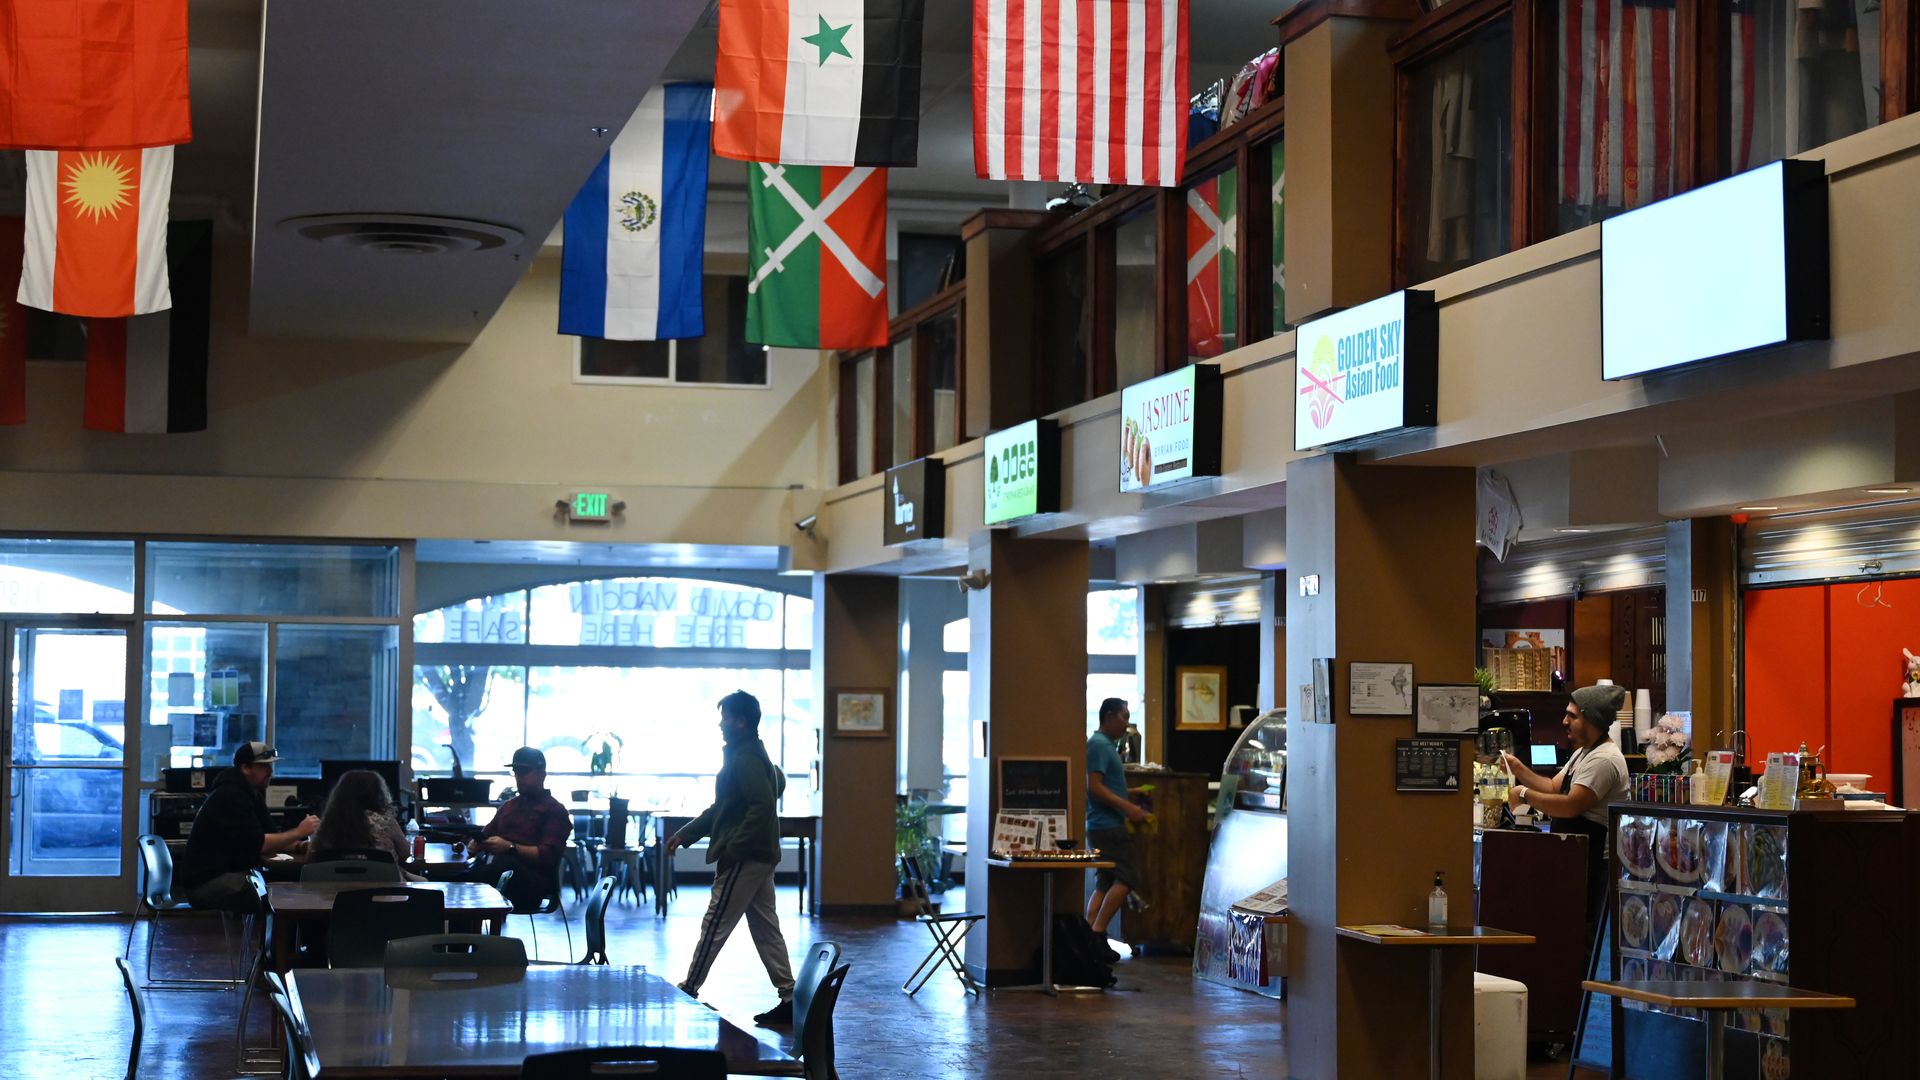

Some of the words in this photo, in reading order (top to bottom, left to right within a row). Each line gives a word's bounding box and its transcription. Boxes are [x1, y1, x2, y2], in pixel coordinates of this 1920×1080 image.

[1337, 327, 1377, 373] GOLDEN
[1380, 319, 1402, 361] SKY
[1345, 368, 1373, 401] Asian
[1375, 356, 1399, 393] Food
[1139, 388, 1190, 435] JASMINE
[1174, 438, 1189, 452] FOOD
[576, 493, 608, 517] EXIT
[1693, 590, 1705, 601] 117
